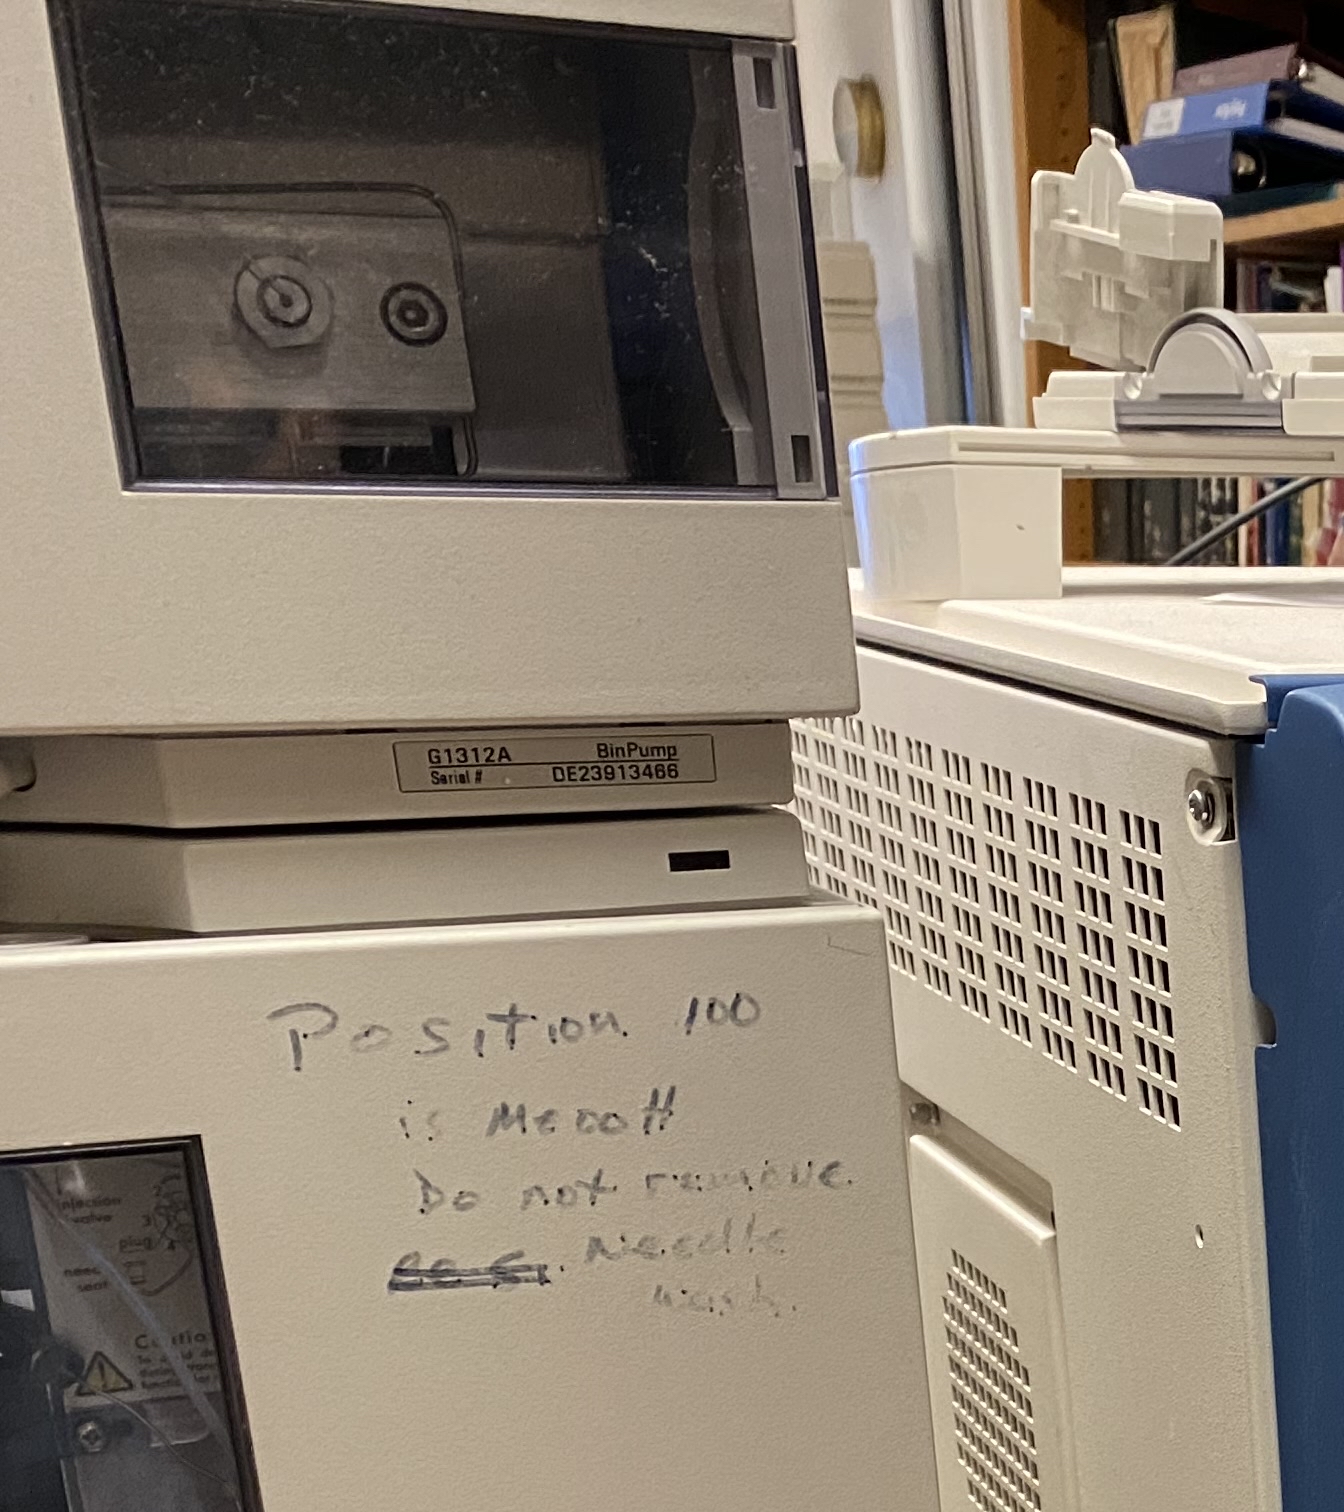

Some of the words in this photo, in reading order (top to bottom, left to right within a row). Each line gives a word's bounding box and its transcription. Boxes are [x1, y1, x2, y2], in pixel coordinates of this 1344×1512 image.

[428, 747, 512, 764] G1312A
[597, 743, 677, 760] BinPump
[431, 769, 470, 785] Serial
[268, 1002, 628, 1072] Position
[679, 994, 760, 1034] 100
[400, 1100, 441, 1141] is
[413, 1169, 478, 1214] Do
[520, 1169, 618, 1209] not
